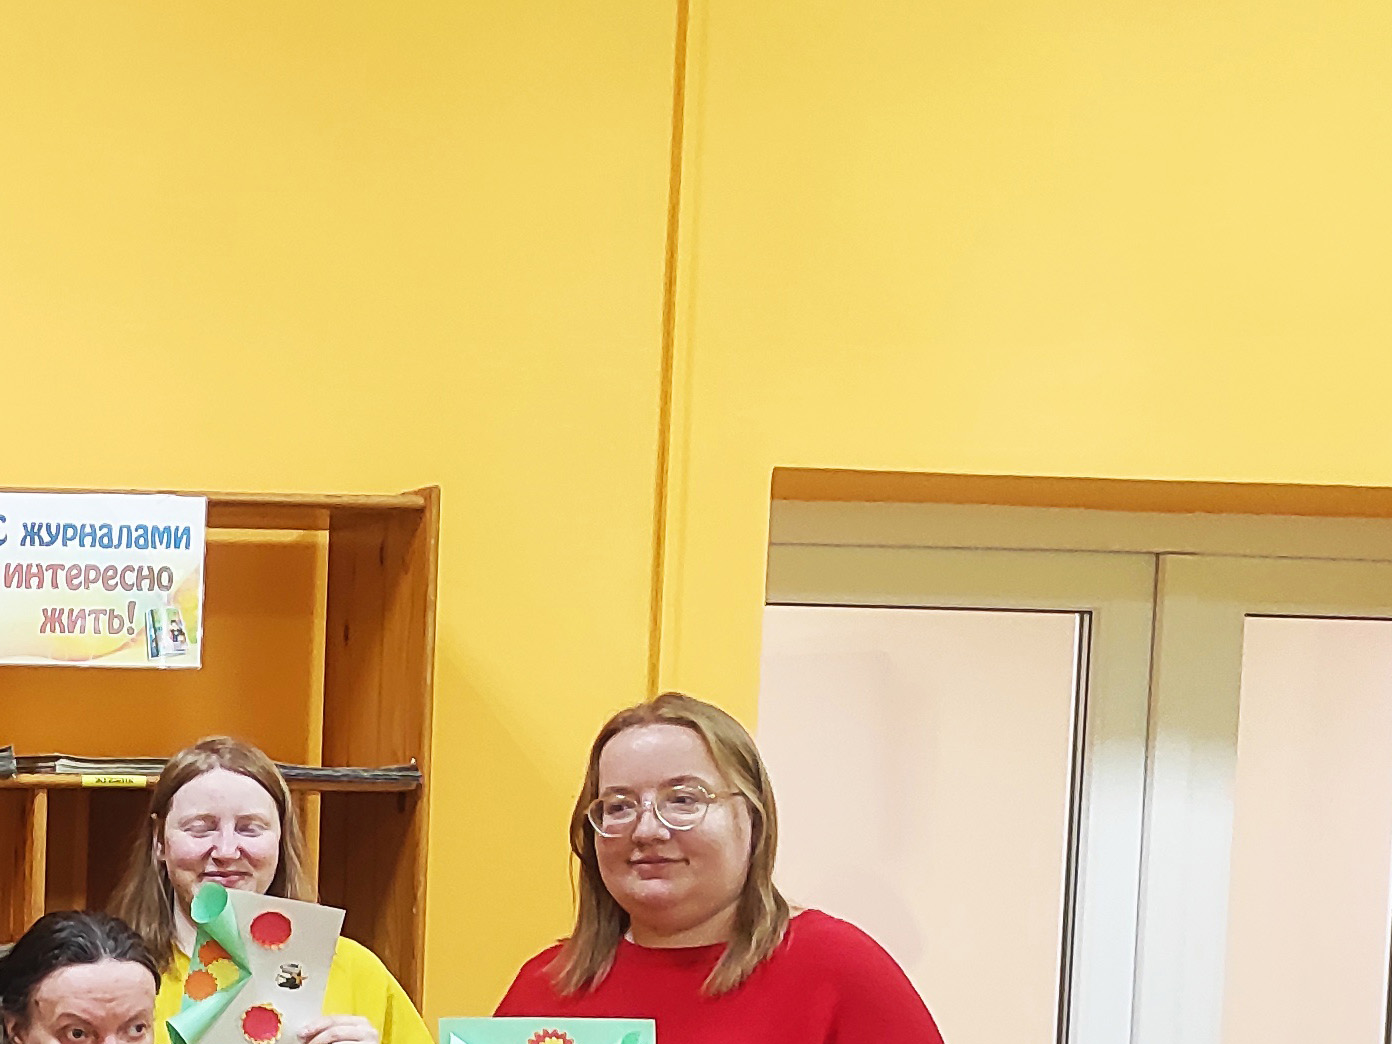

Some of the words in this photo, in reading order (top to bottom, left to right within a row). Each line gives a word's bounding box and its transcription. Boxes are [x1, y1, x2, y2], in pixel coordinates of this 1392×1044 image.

[20, 522, 191, 550] журналами
[3, 563, 173, 591] интересно
[40, 601, 136, 635] жить!
